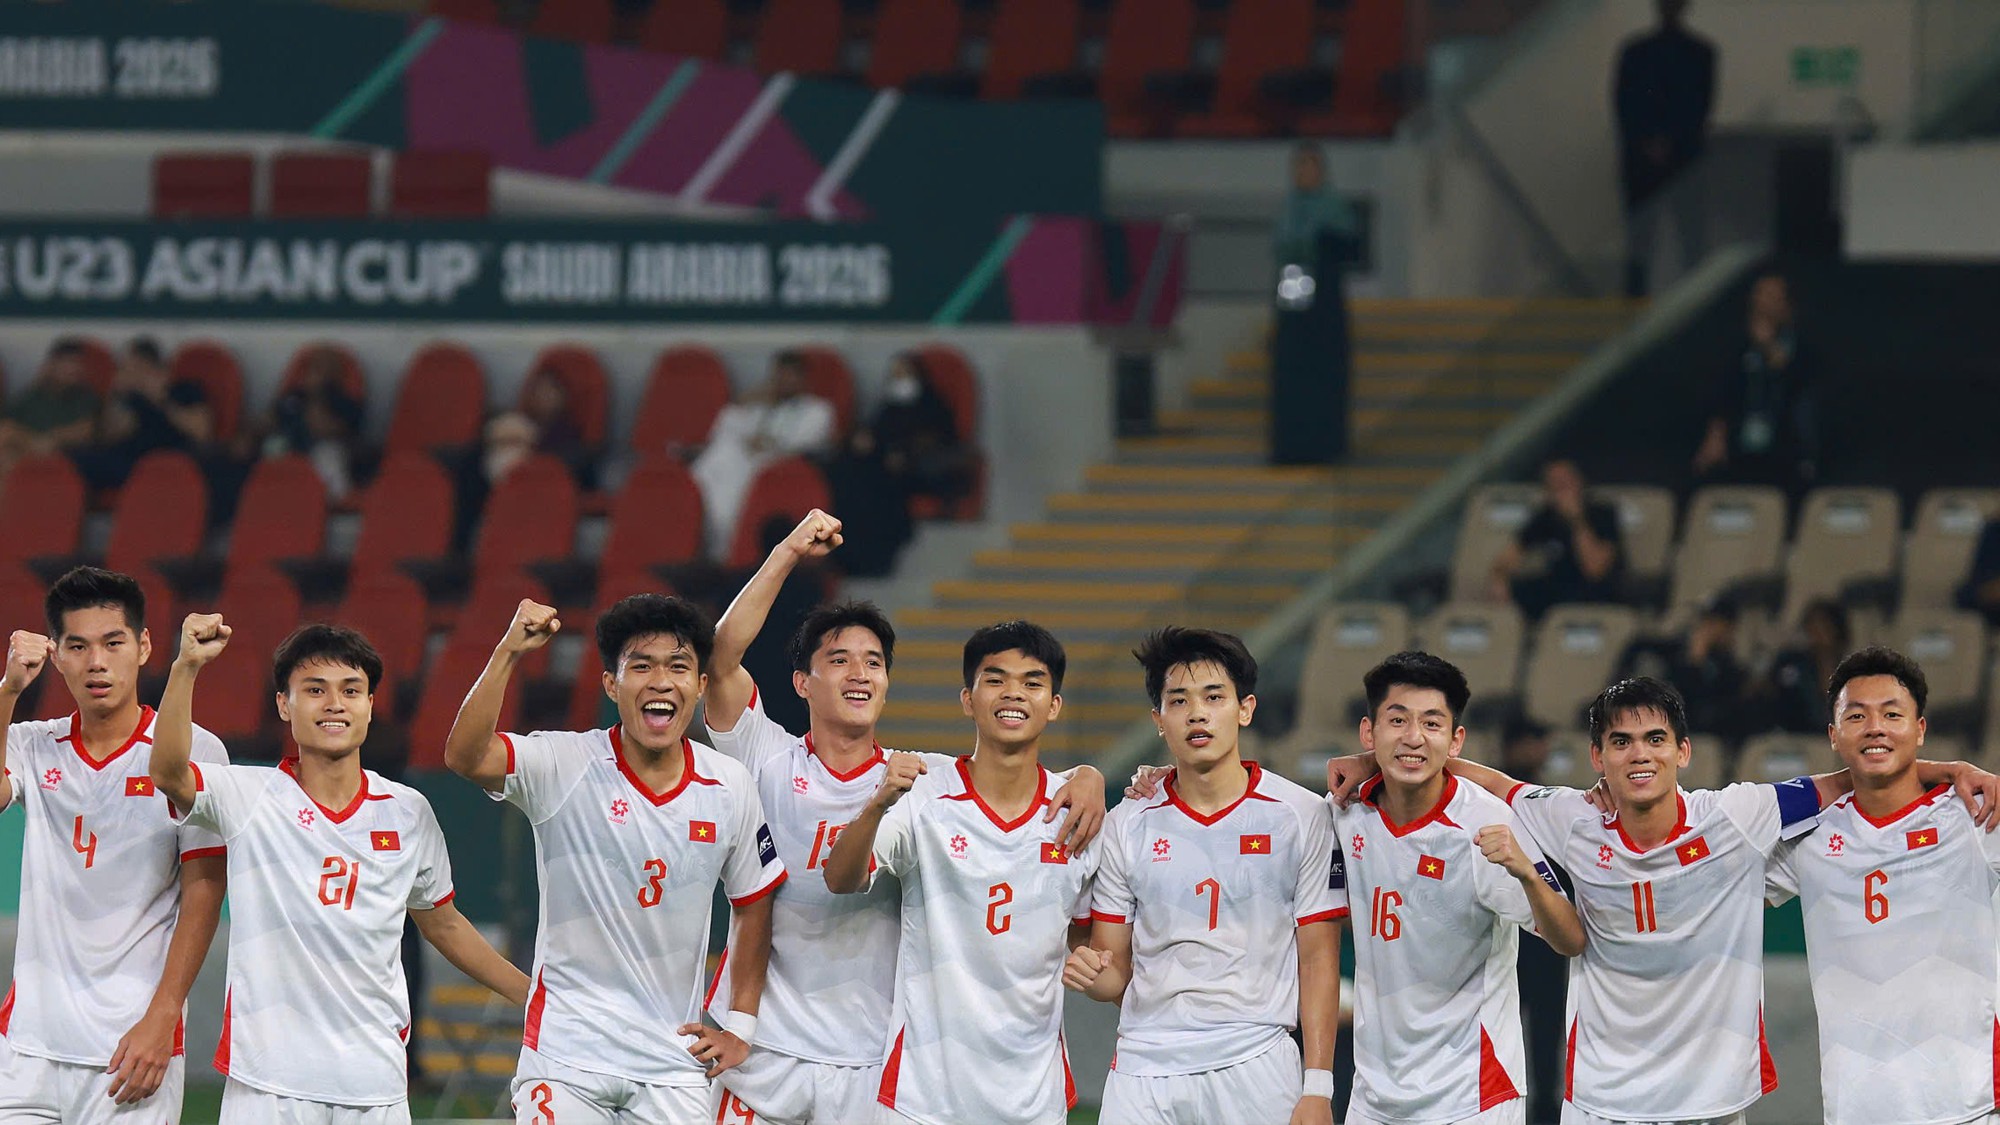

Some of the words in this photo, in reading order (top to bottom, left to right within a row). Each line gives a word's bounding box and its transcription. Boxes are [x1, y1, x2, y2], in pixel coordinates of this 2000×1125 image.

[16, 239, 134, 300] U23
[142, 239, 337, 301] ASIAN
[344, 239, 477, 302] CUP
[502, 244, 622, 304] SAUDI
[627, 244, 771, 304] ARABIA
[780, 244, 889, 305] 2026
[73, 815, 97, 869] 4
[759, 834, 772, 853] AFC
[318, 856, 359, 910] 21
[637, 858, 667, 908] 3
[986, 882, 1013, 935] 2
[1195, 877, 1220, 931] 7
[1632, 881, 1657, 933] 11
[1864, 869, 1889, 924] 6
[1371, 886, 1403, 941] 16
[530, 1082, 555, 1125] 3
